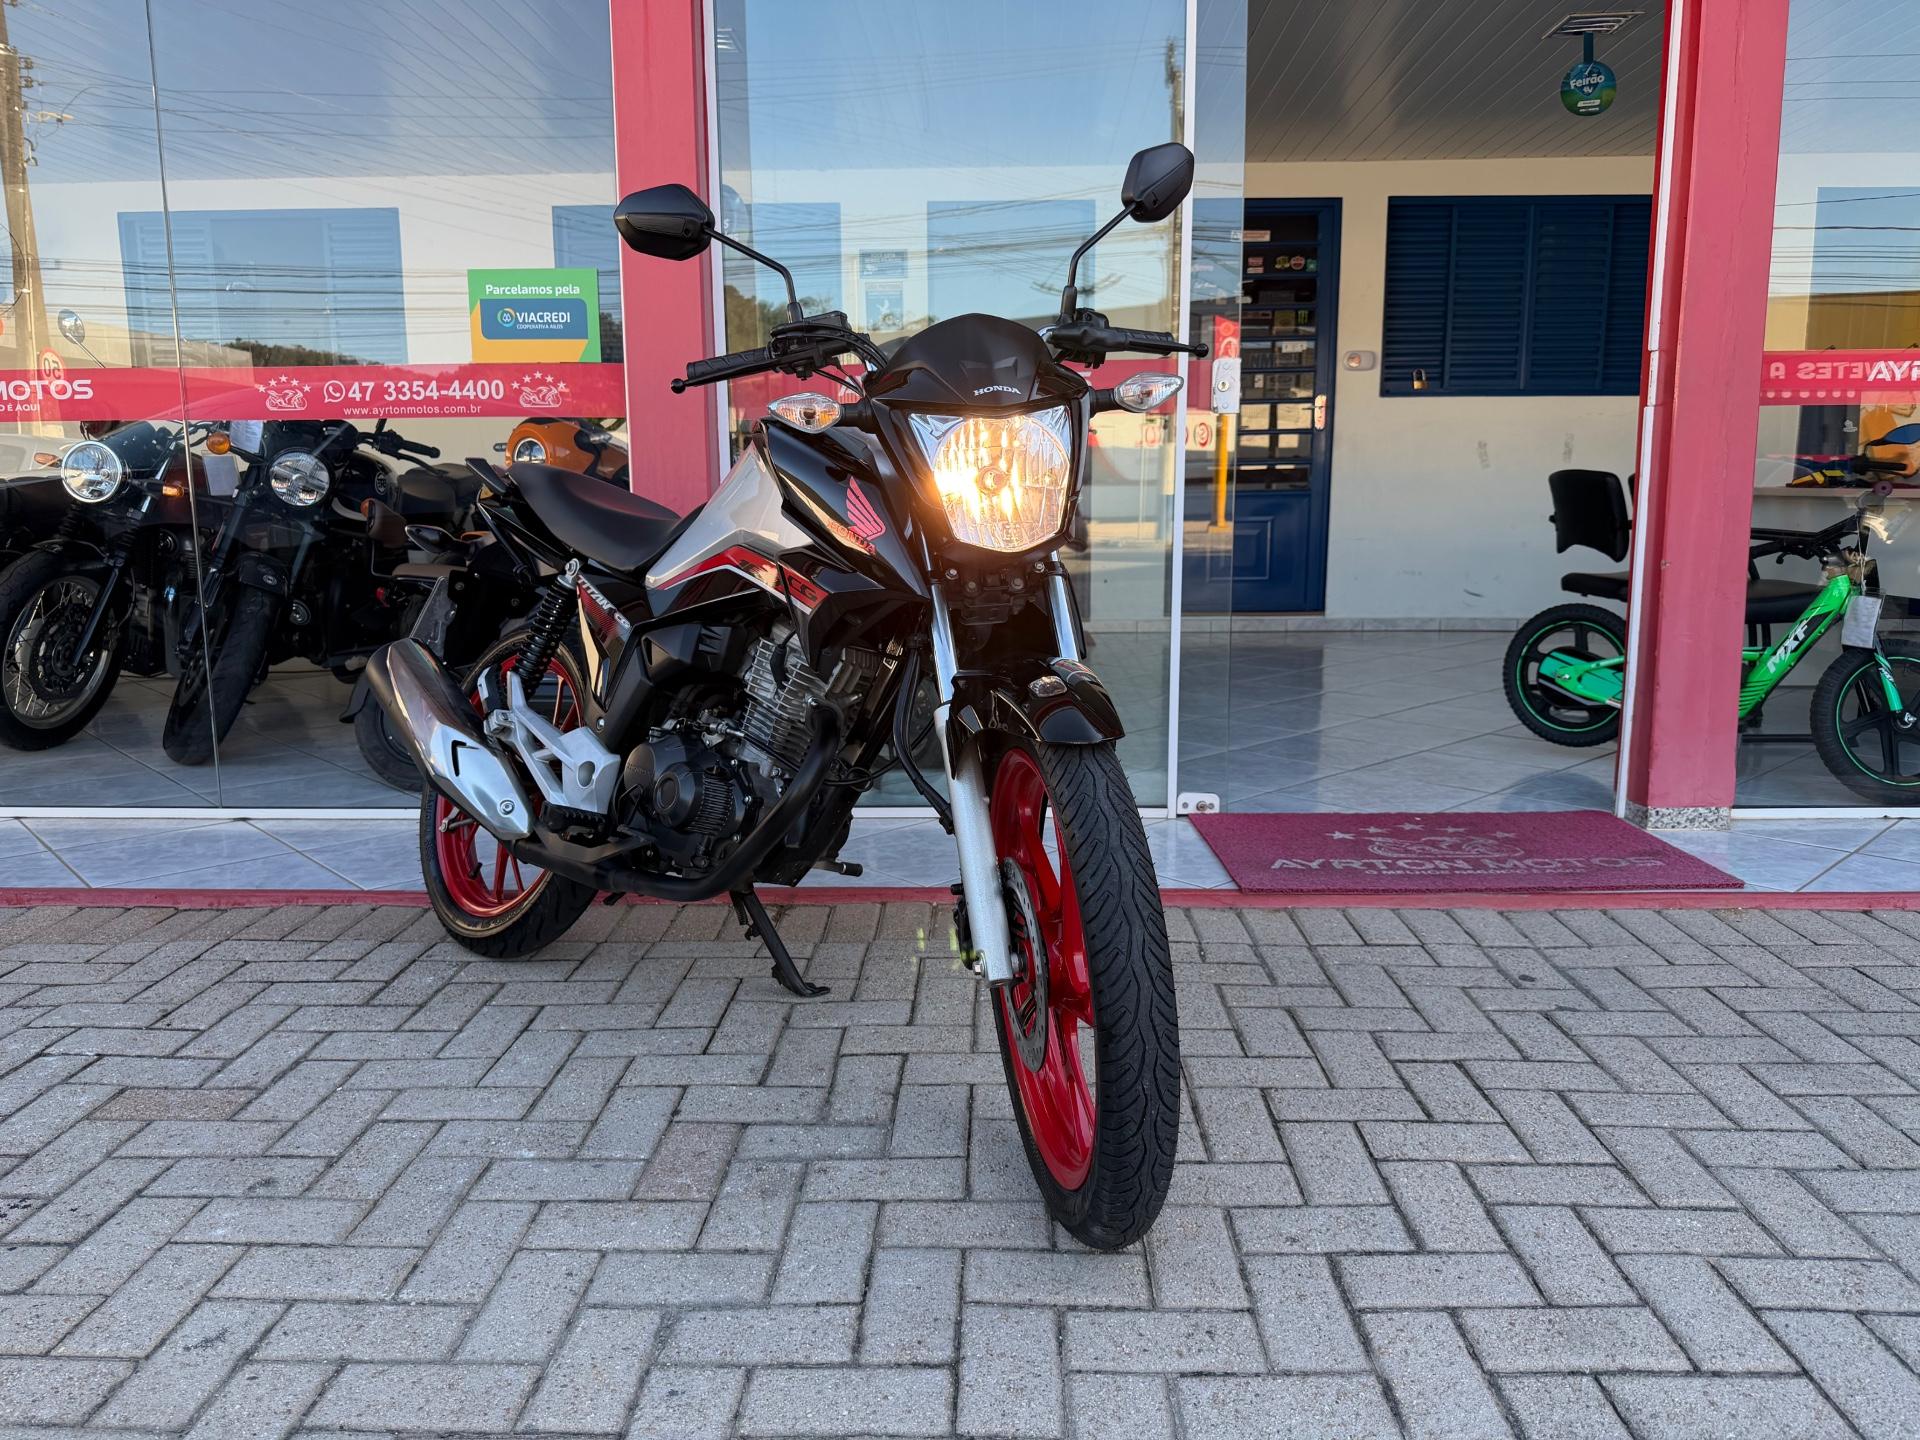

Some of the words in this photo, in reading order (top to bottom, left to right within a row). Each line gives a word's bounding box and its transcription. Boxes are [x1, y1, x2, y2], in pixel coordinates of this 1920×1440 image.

[1569, 74, 1605, 89] Feirão
[485, 284, 553, 295] Parcelamos
[555, 285, 580, 296] pela
[516, 311, 571, 323] VIACREDI
[348, 381, 375, 401] 47
[384, 379, 505, 401] 3354-4400
[973, 385, 1022, 396] HONDA
[15, 404, 40, 412] AQUI
[343, 404, 481, 416] www.ayrtonmotos.com.br
[827, 520, 877, 555] HONDA
[578, 574, 618, 611] TITAN
[788, 575, 818, 601] CG
[1766, 619, 1808, 675] MXF
[1270, 858, 1474, 870] AYRTON
[1481, 856, 1667, 869] MOTOS
